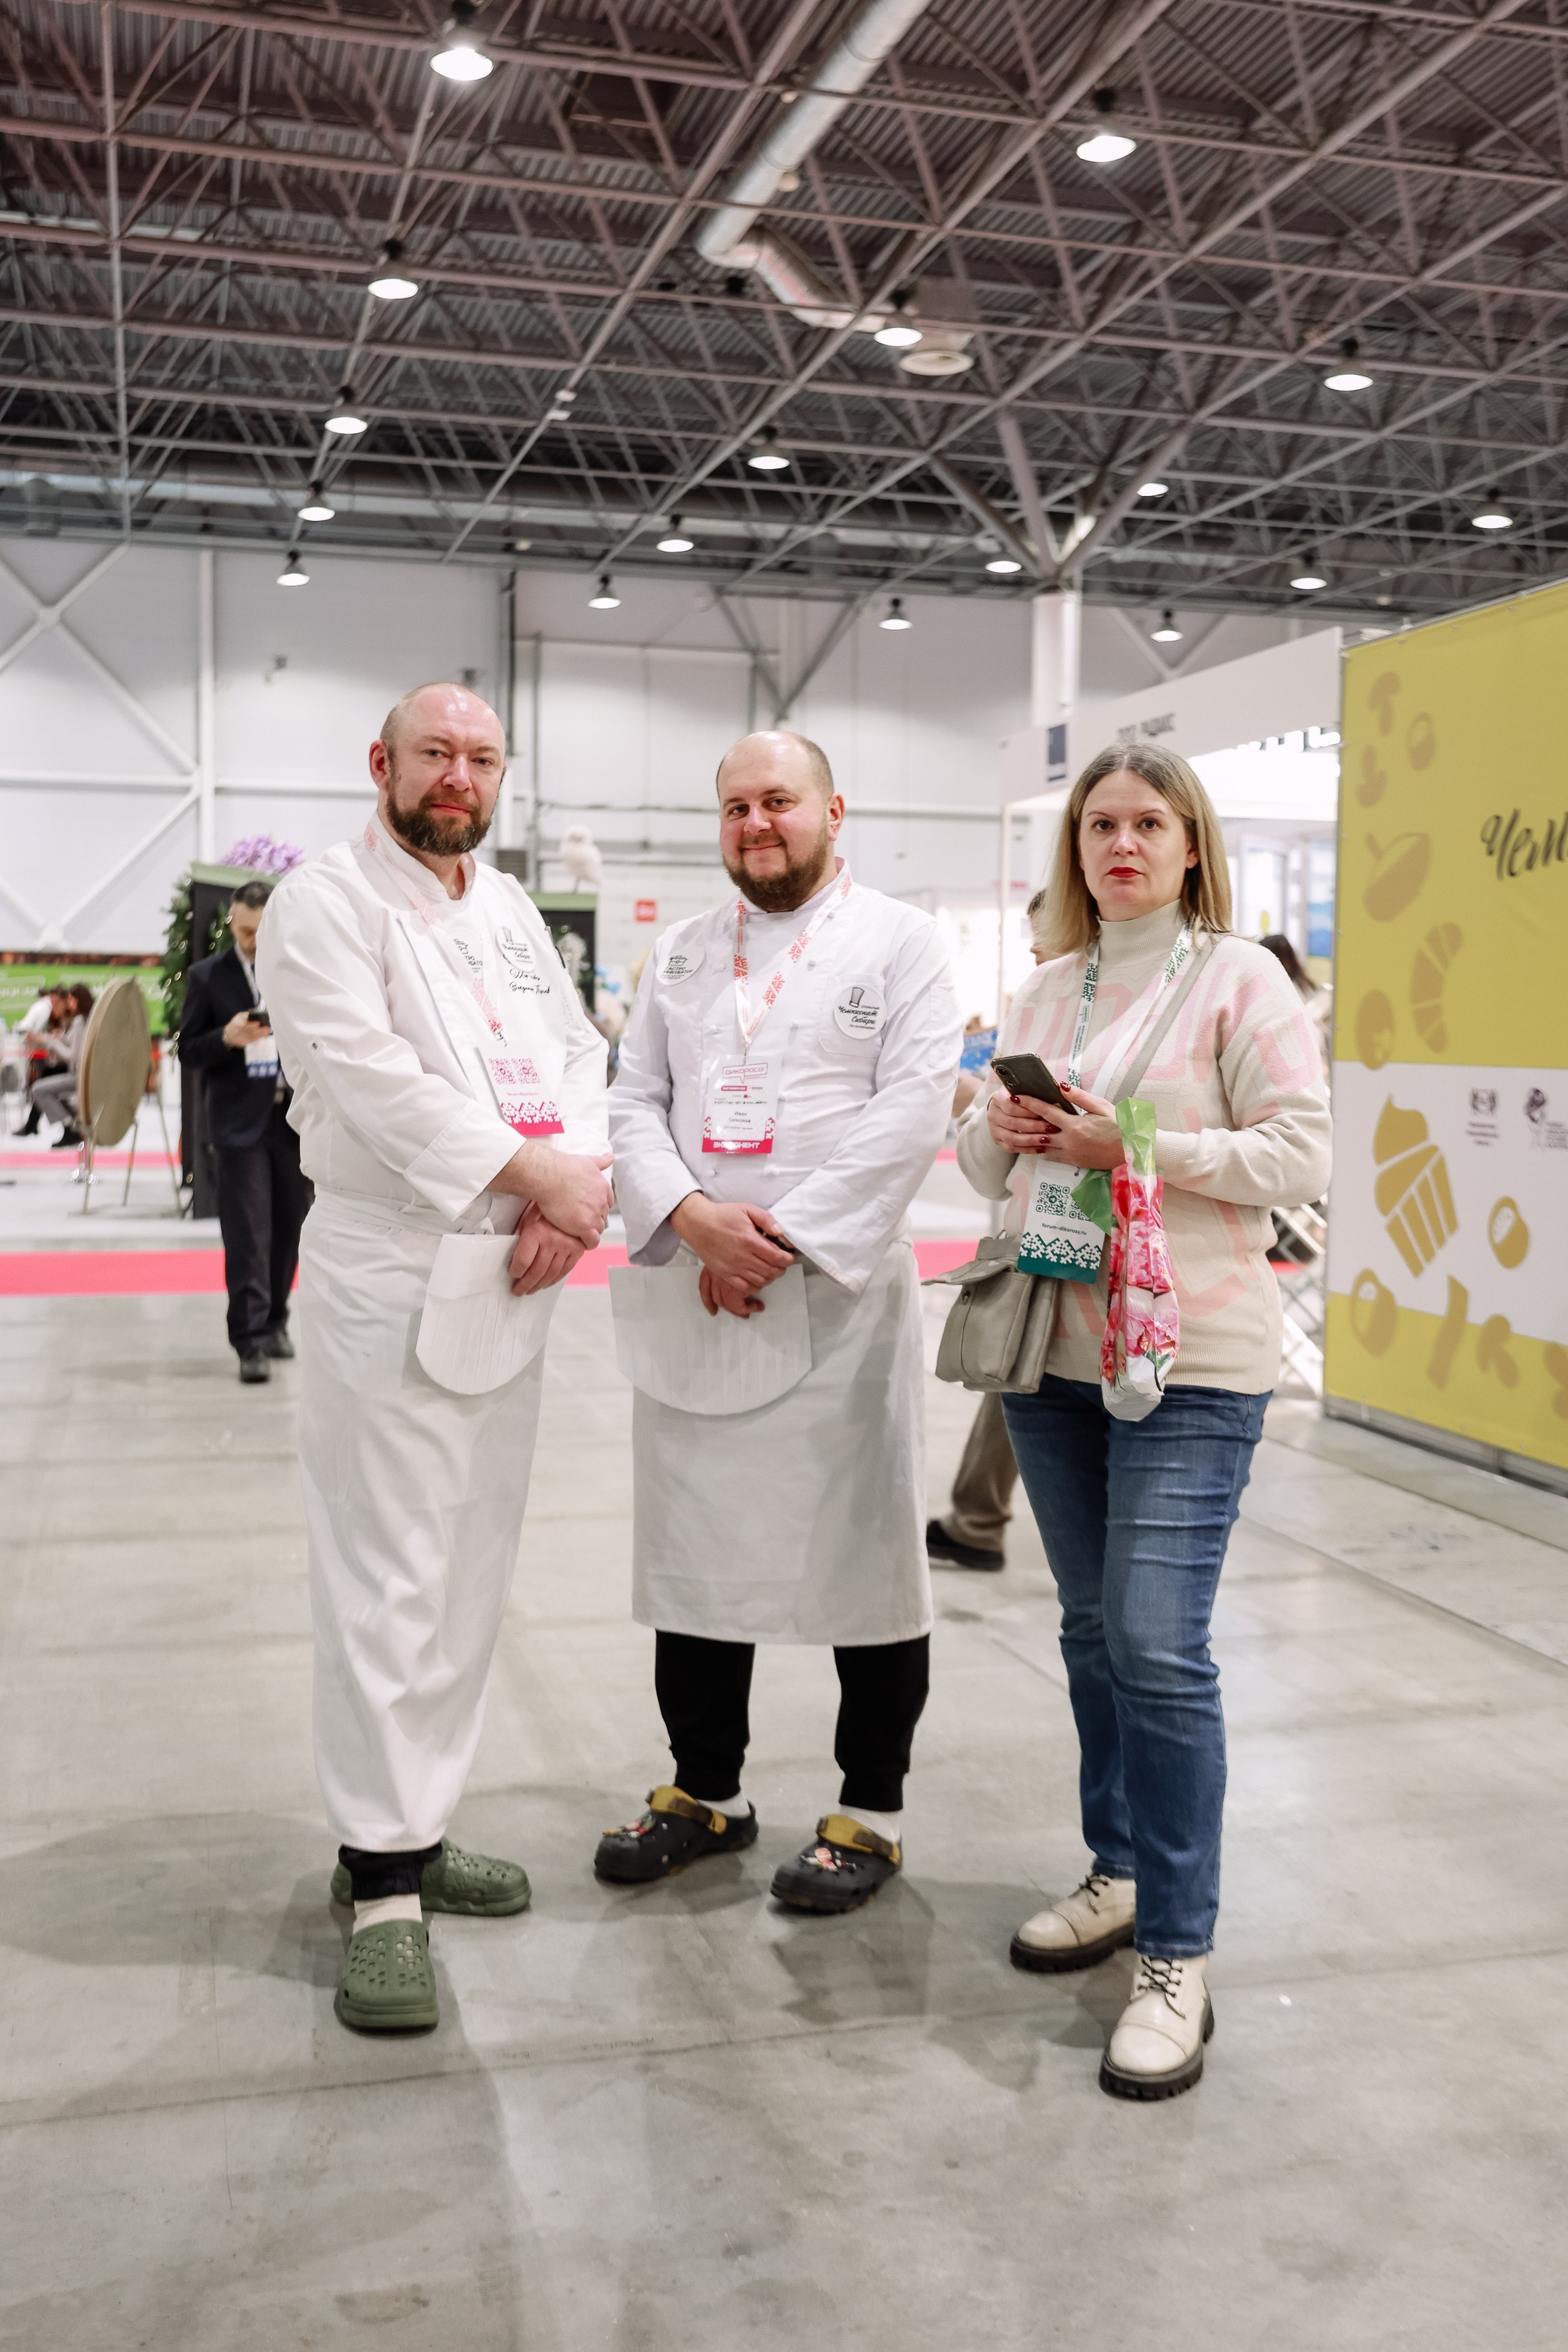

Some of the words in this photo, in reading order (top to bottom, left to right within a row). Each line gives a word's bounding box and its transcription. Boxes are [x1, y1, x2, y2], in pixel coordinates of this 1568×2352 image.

[838, 1006, 877, 1016] Чемпионат
[851, 1016, 876, 1025] Сибири
[1041, 1222, 1088, 1236] forum-dikorosy.ru
